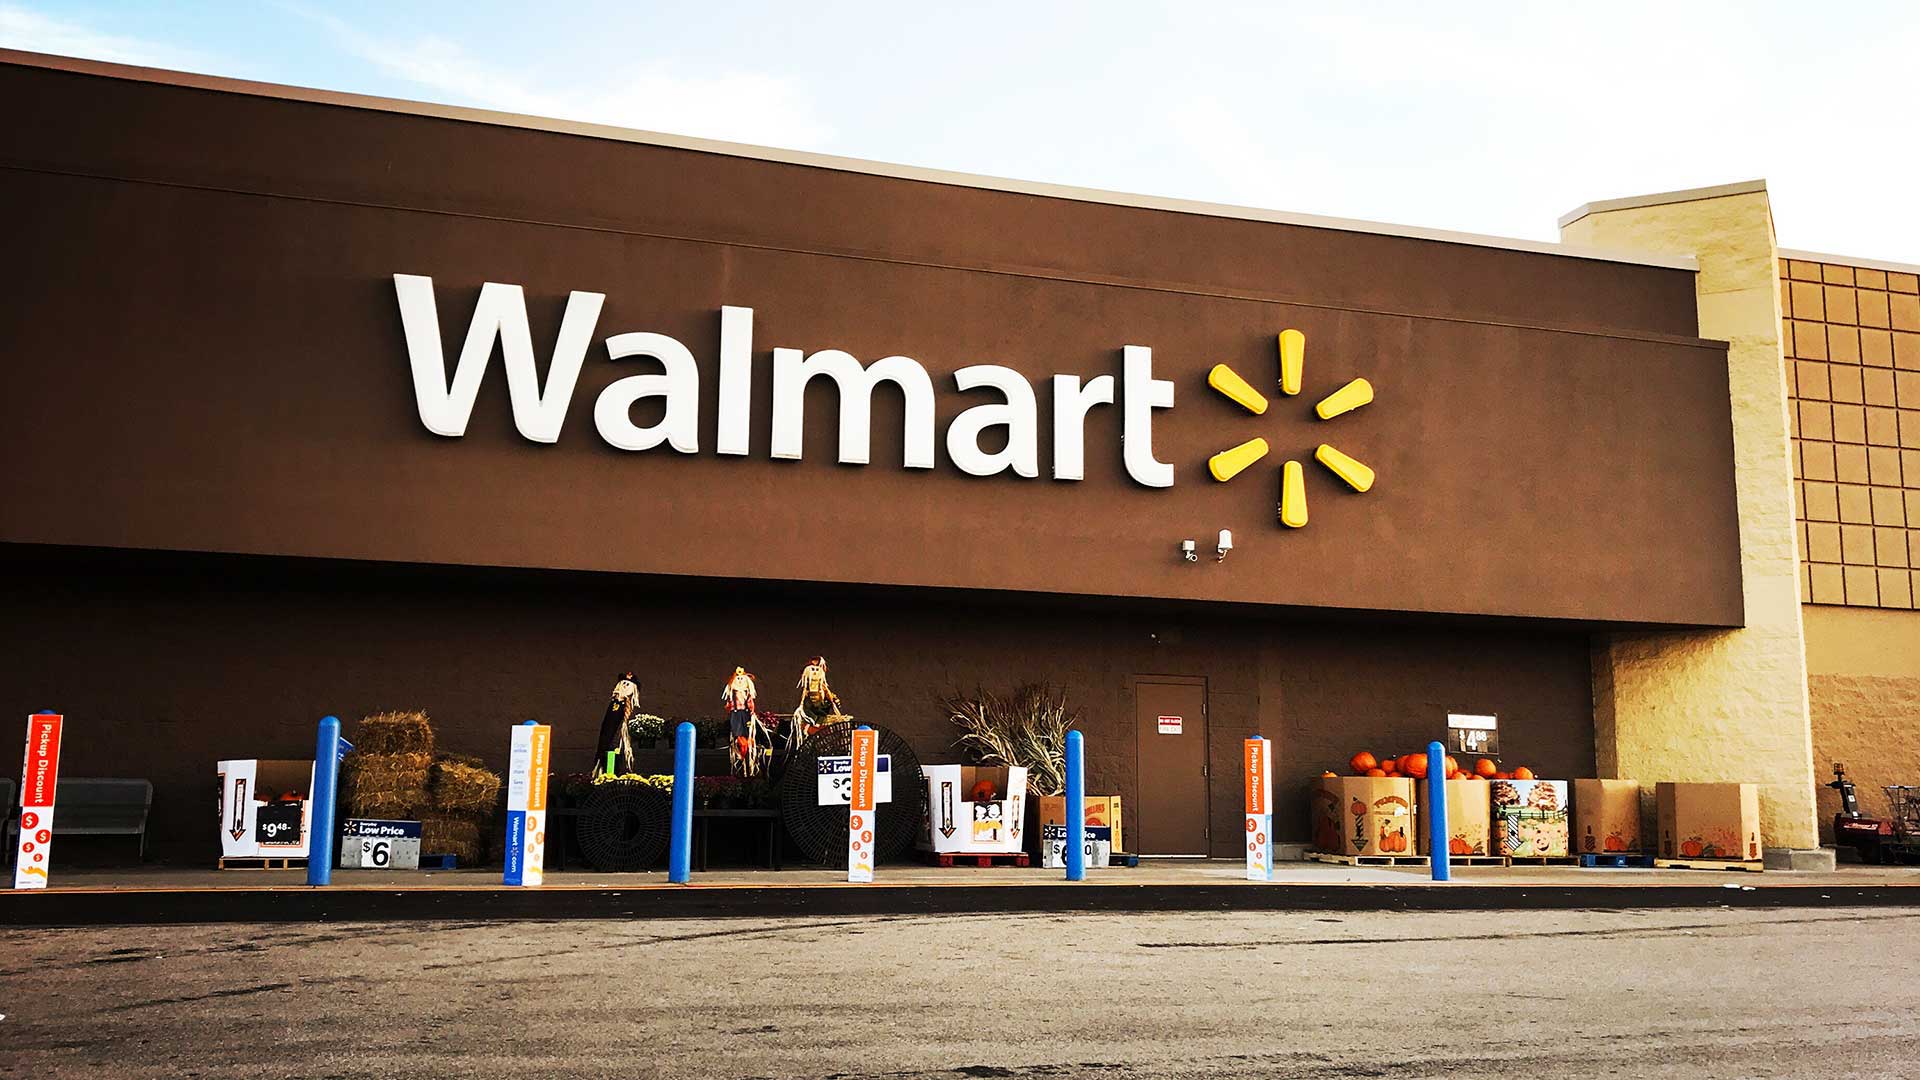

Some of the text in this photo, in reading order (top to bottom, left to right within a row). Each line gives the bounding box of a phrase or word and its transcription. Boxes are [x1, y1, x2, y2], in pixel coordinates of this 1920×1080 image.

[393, 273, 1175, 488] Walmart
[37, 724, 52, 757] Pickup
[859, 737, 869, 767] Pickup
[533, 734, 545, 808] Pickup Discount
[1250, 747, 1259, 774] Pickup
[34, 759, 49, 804] Discount
[858, 769, 868, 808] Discount
[1251, 775, 1260, 812] Discount
[359, 825, 405, 836] Low Price
[512, 816, 520, 847] Walmart
[363, 841, 390, 867] $6
